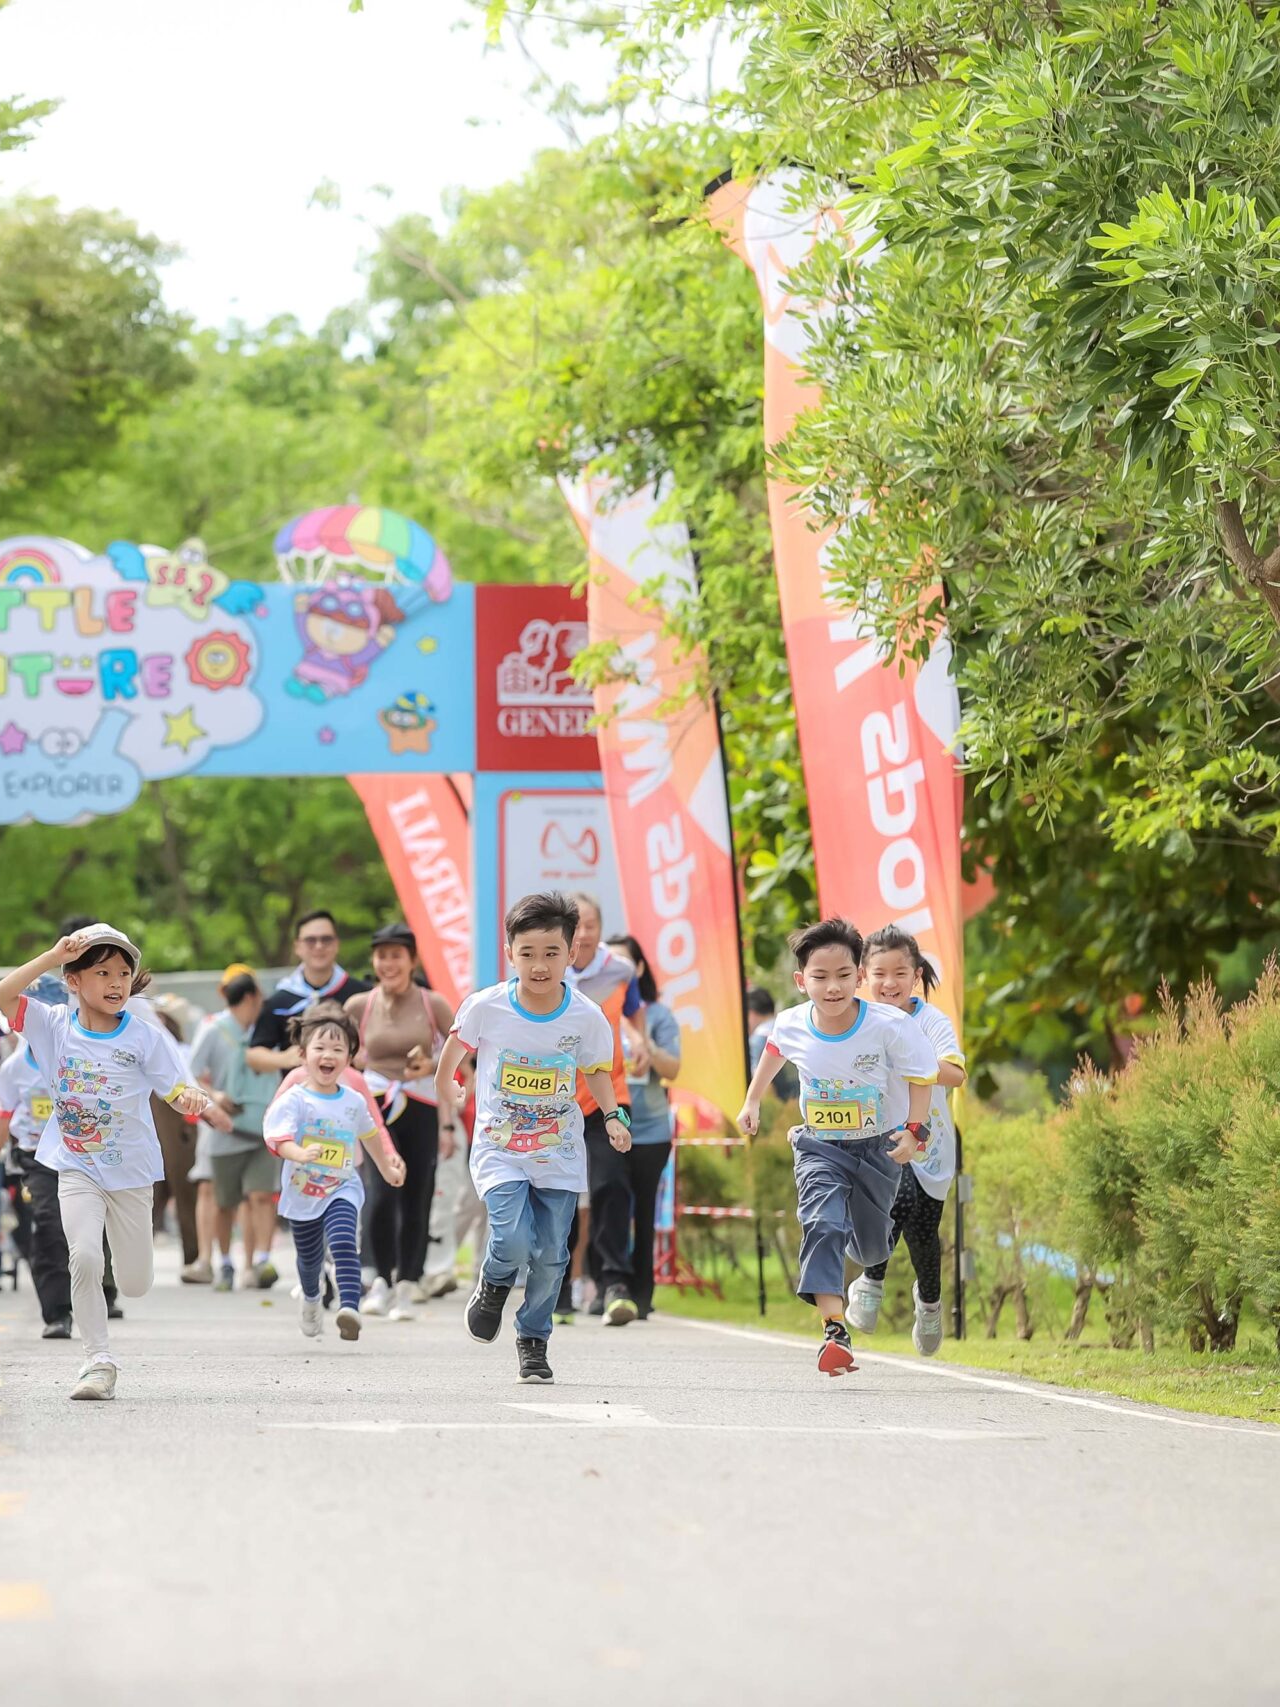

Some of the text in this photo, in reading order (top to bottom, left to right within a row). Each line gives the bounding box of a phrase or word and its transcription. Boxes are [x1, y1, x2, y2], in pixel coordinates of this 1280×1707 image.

[497, 706, 598, 737] GENER
[3, 770, 124, 799] EXPLORER
[506, 1073, 569, 1093] 2048 A
[814, 1111, 851, 1124] 2101
[864, 1116, 875, 1127] A
